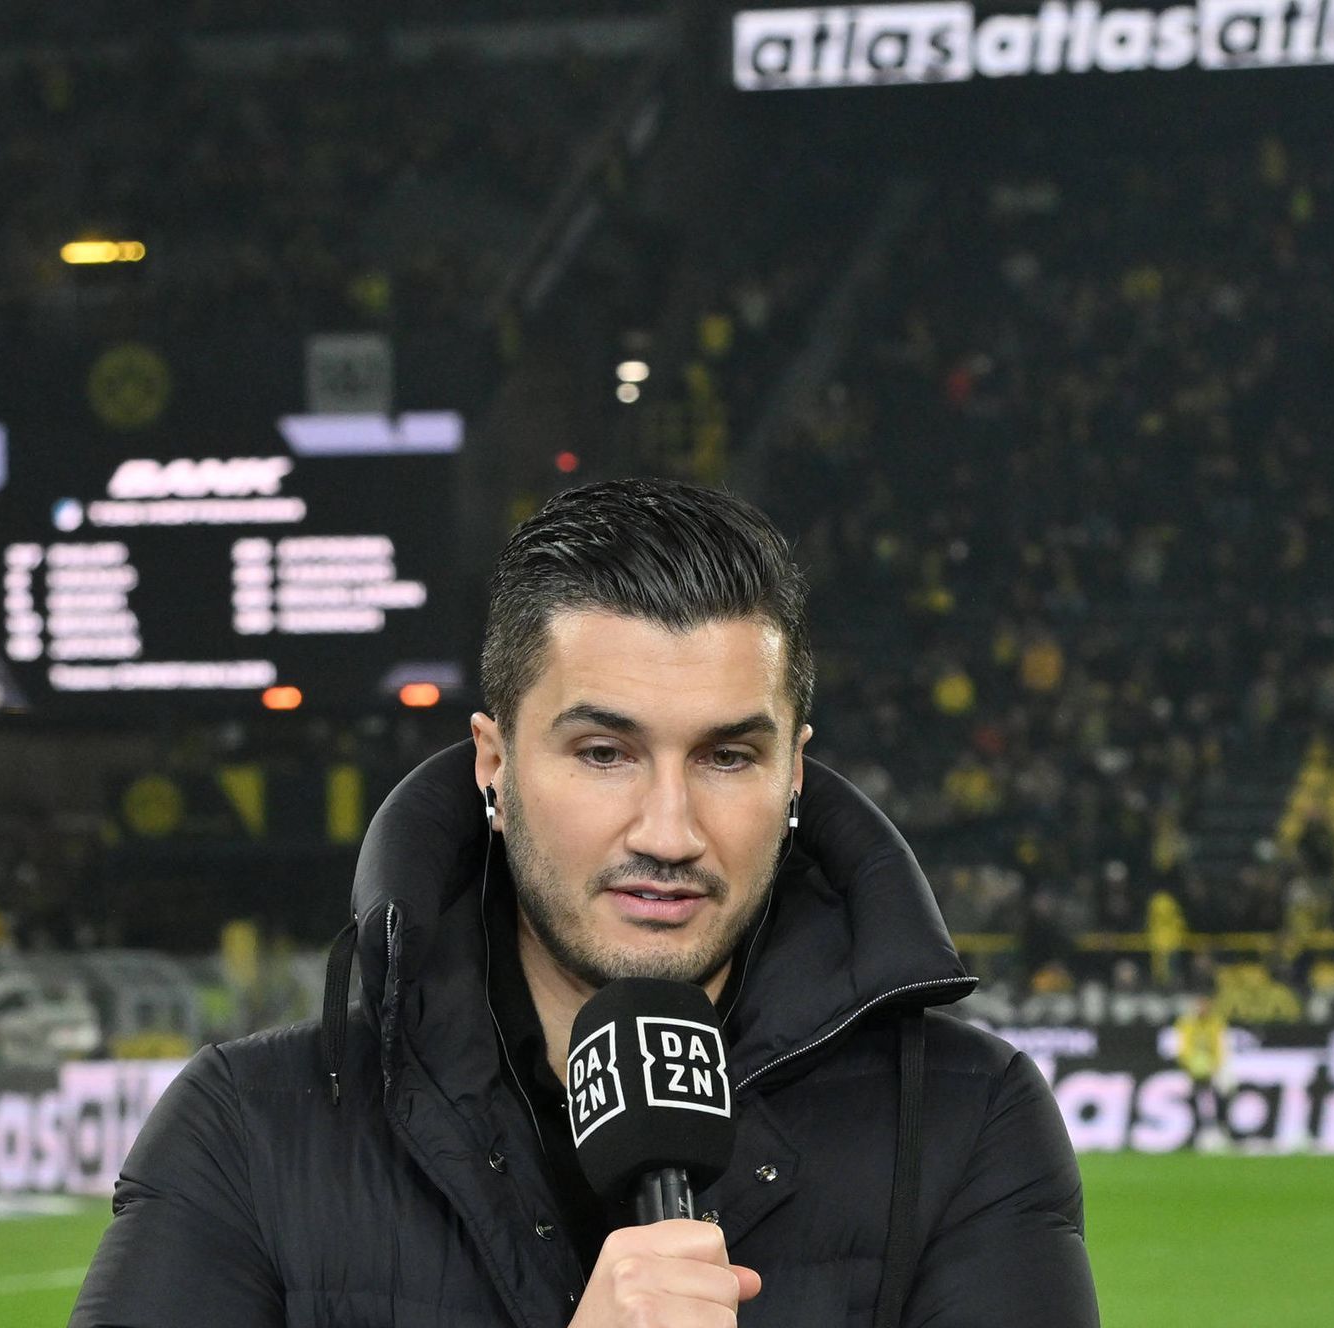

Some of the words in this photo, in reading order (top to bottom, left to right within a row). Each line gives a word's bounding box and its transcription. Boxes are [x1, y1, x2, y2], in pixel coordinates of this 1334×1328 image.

[750, 14, 954, 82] atlas
[975, 0, 1196, 77] atlas
[573, 1047, 602, 1090] DA
[660, 1031, 710, 1064] DA
[576, 1077, 606, 1123] ZN
[665, 1063, 713, 1097] ZN
